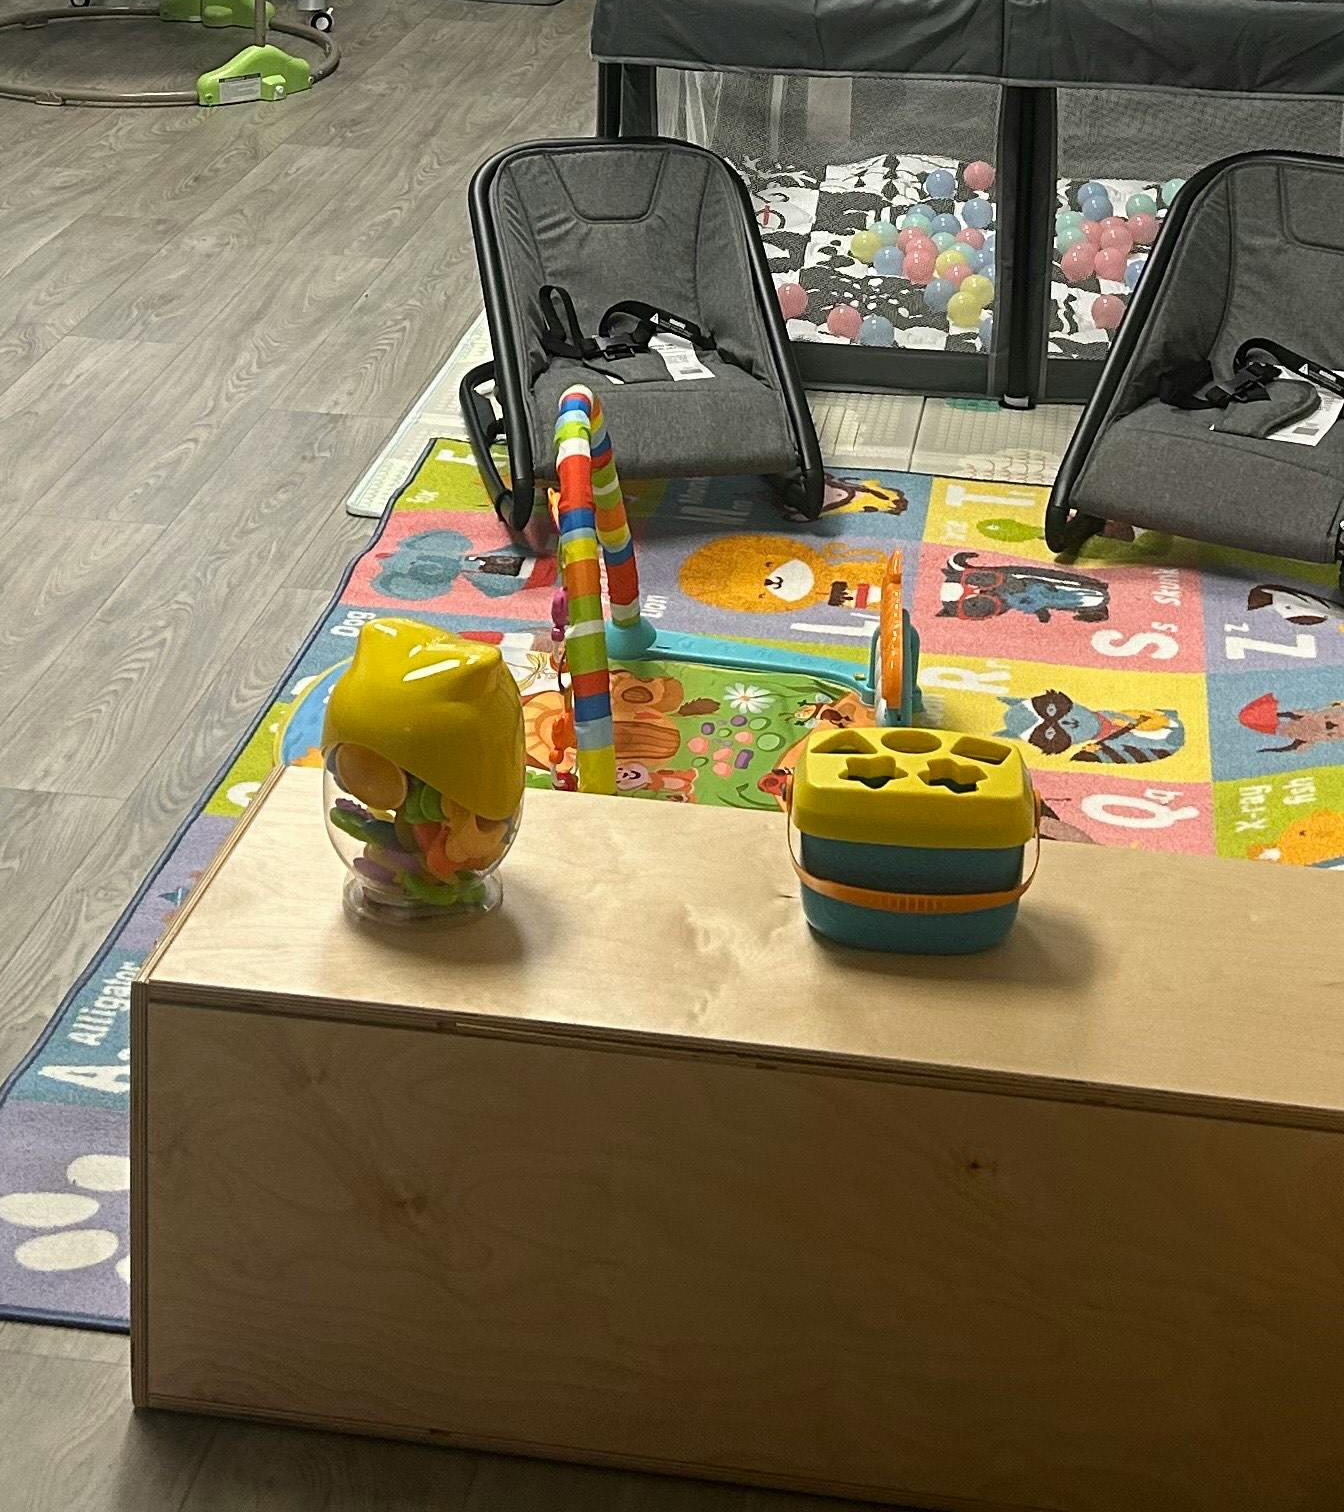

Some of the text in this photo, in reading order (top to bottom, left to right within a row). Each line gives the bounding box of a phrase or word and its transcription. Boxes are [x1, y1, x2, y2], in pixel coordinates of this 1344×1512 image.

[1152, 568, 1181, 607] Skunk
[330, 610, 377, 637] Dog
[1091, 629, 1179, 660] S
[1224, 634, 1317, 660] Z
[920, 666, 1011, 694] R
[1283, 776, 1315, 805] fish
[1081, 788, 1200, 829] Q q
[1235, 784, 1272, 833] X-ray
[67, 961, 141, 1047] Alligator
[38, 1064, 131, 1094] A
